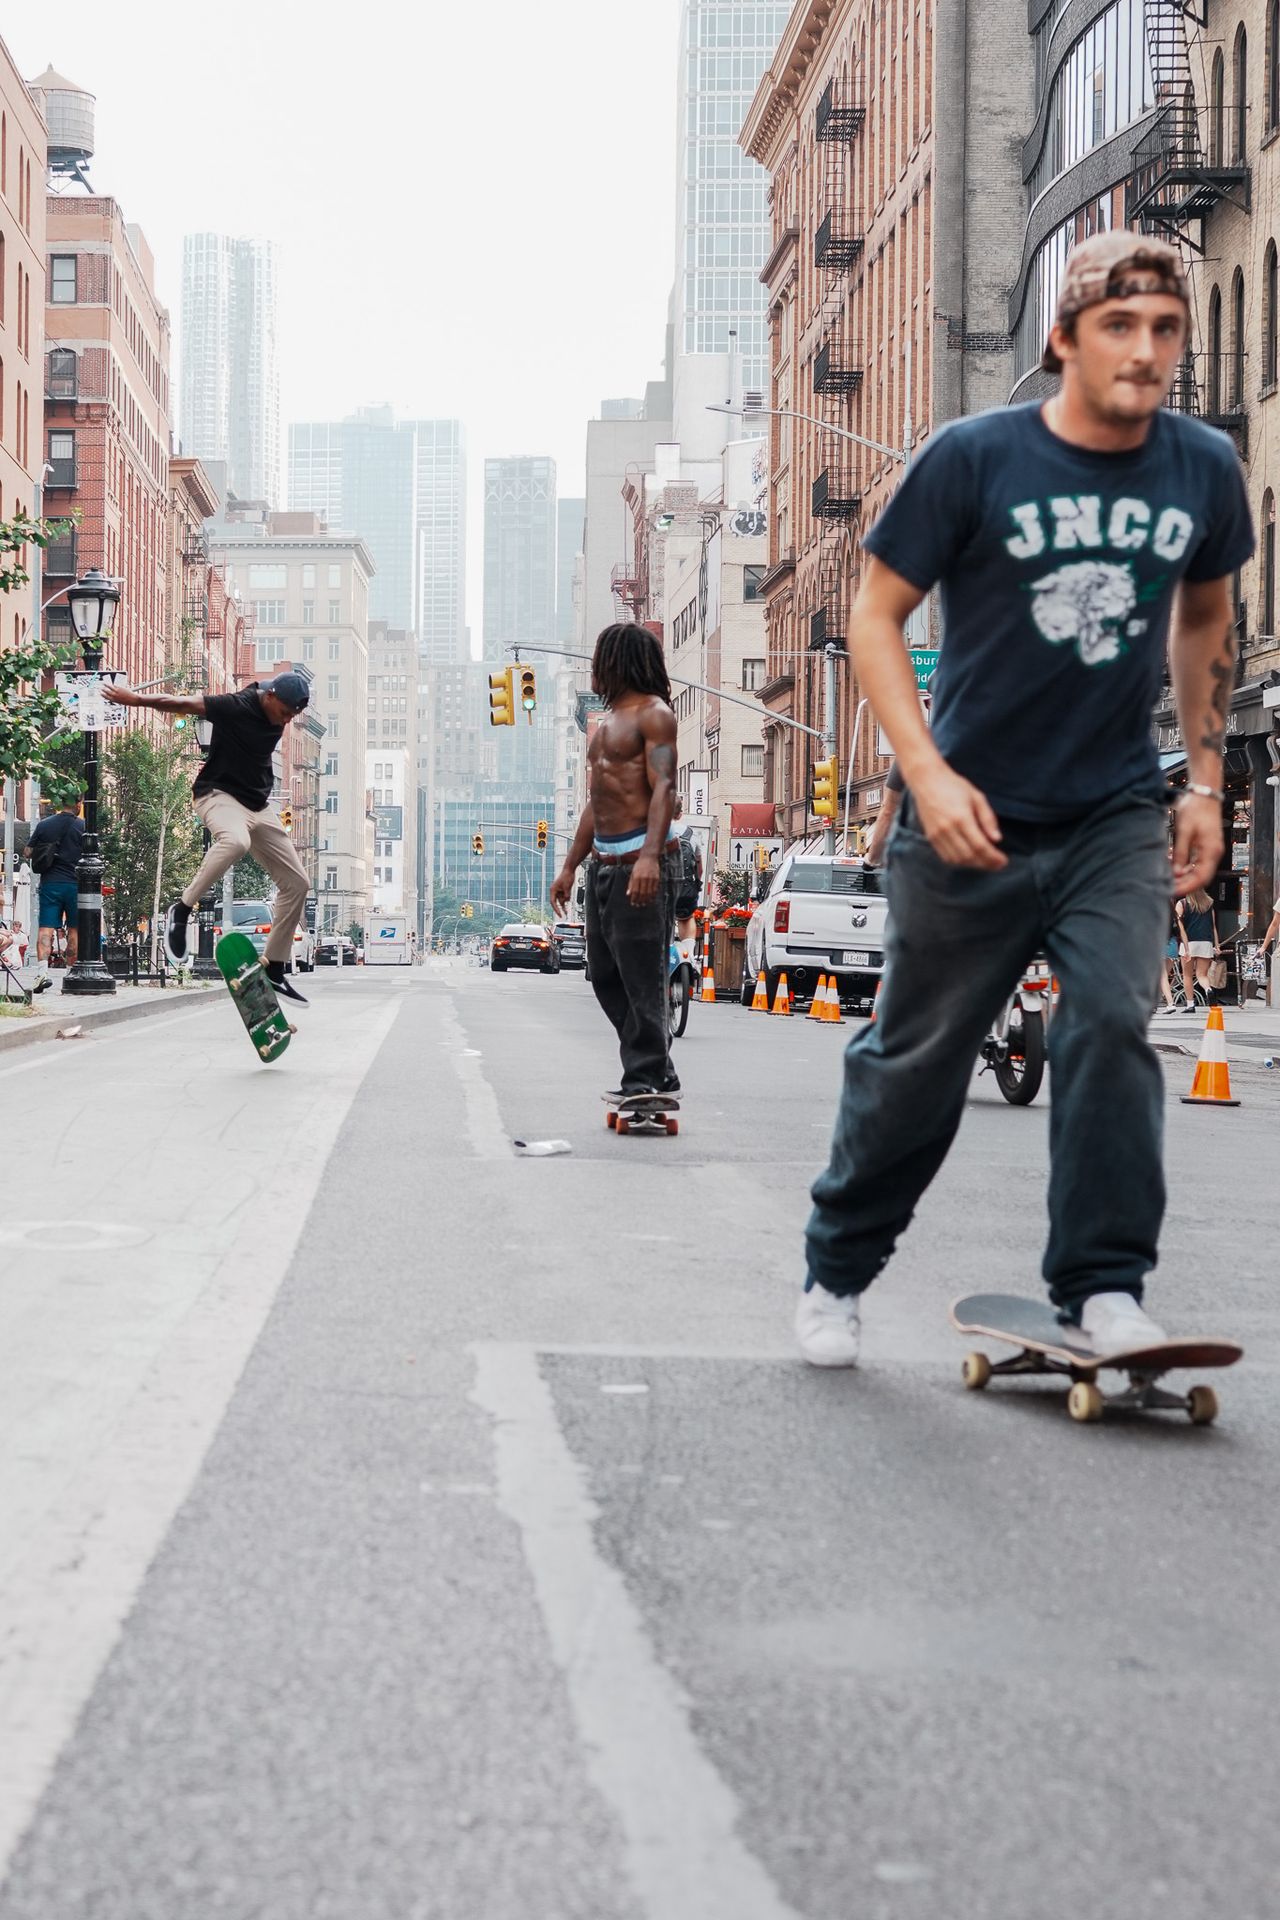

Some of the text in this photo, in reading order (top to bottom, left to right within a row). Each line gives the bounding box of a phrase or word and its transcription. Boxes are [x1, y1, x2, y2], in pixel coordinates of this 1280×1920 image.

[1006, 496, 1194, 562] JNCO
[910, 655, 939, 665] sbur
[732, 827, 774, 836] EATALY
